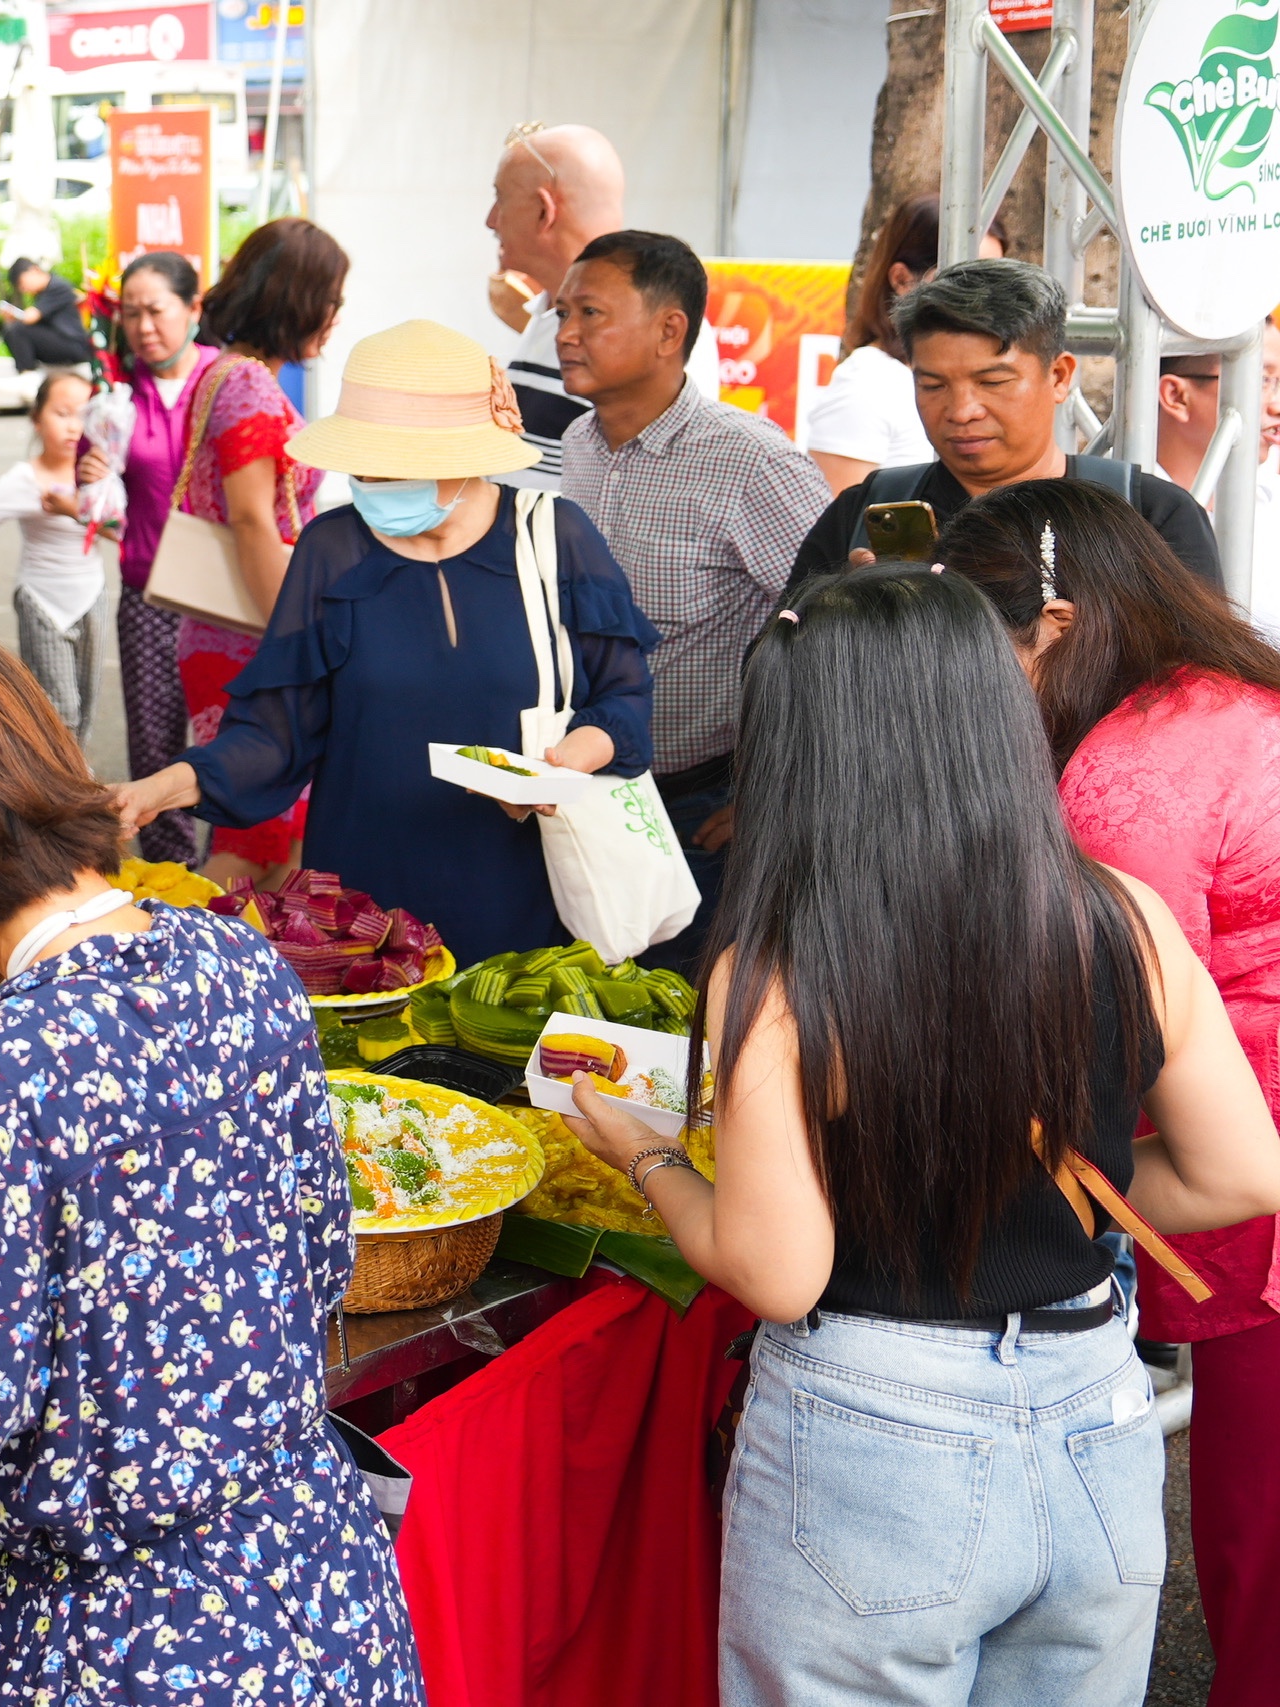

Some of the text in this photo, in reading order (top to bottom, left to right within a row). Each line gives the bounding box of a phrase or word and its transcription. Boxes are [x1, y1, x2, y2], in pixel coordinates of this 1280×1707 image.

[1170, 63, 1235, 125] Chè
[1140, 220, 1172, 244] CHÈ
[1218, 212, 1257, 234] VĨNH
